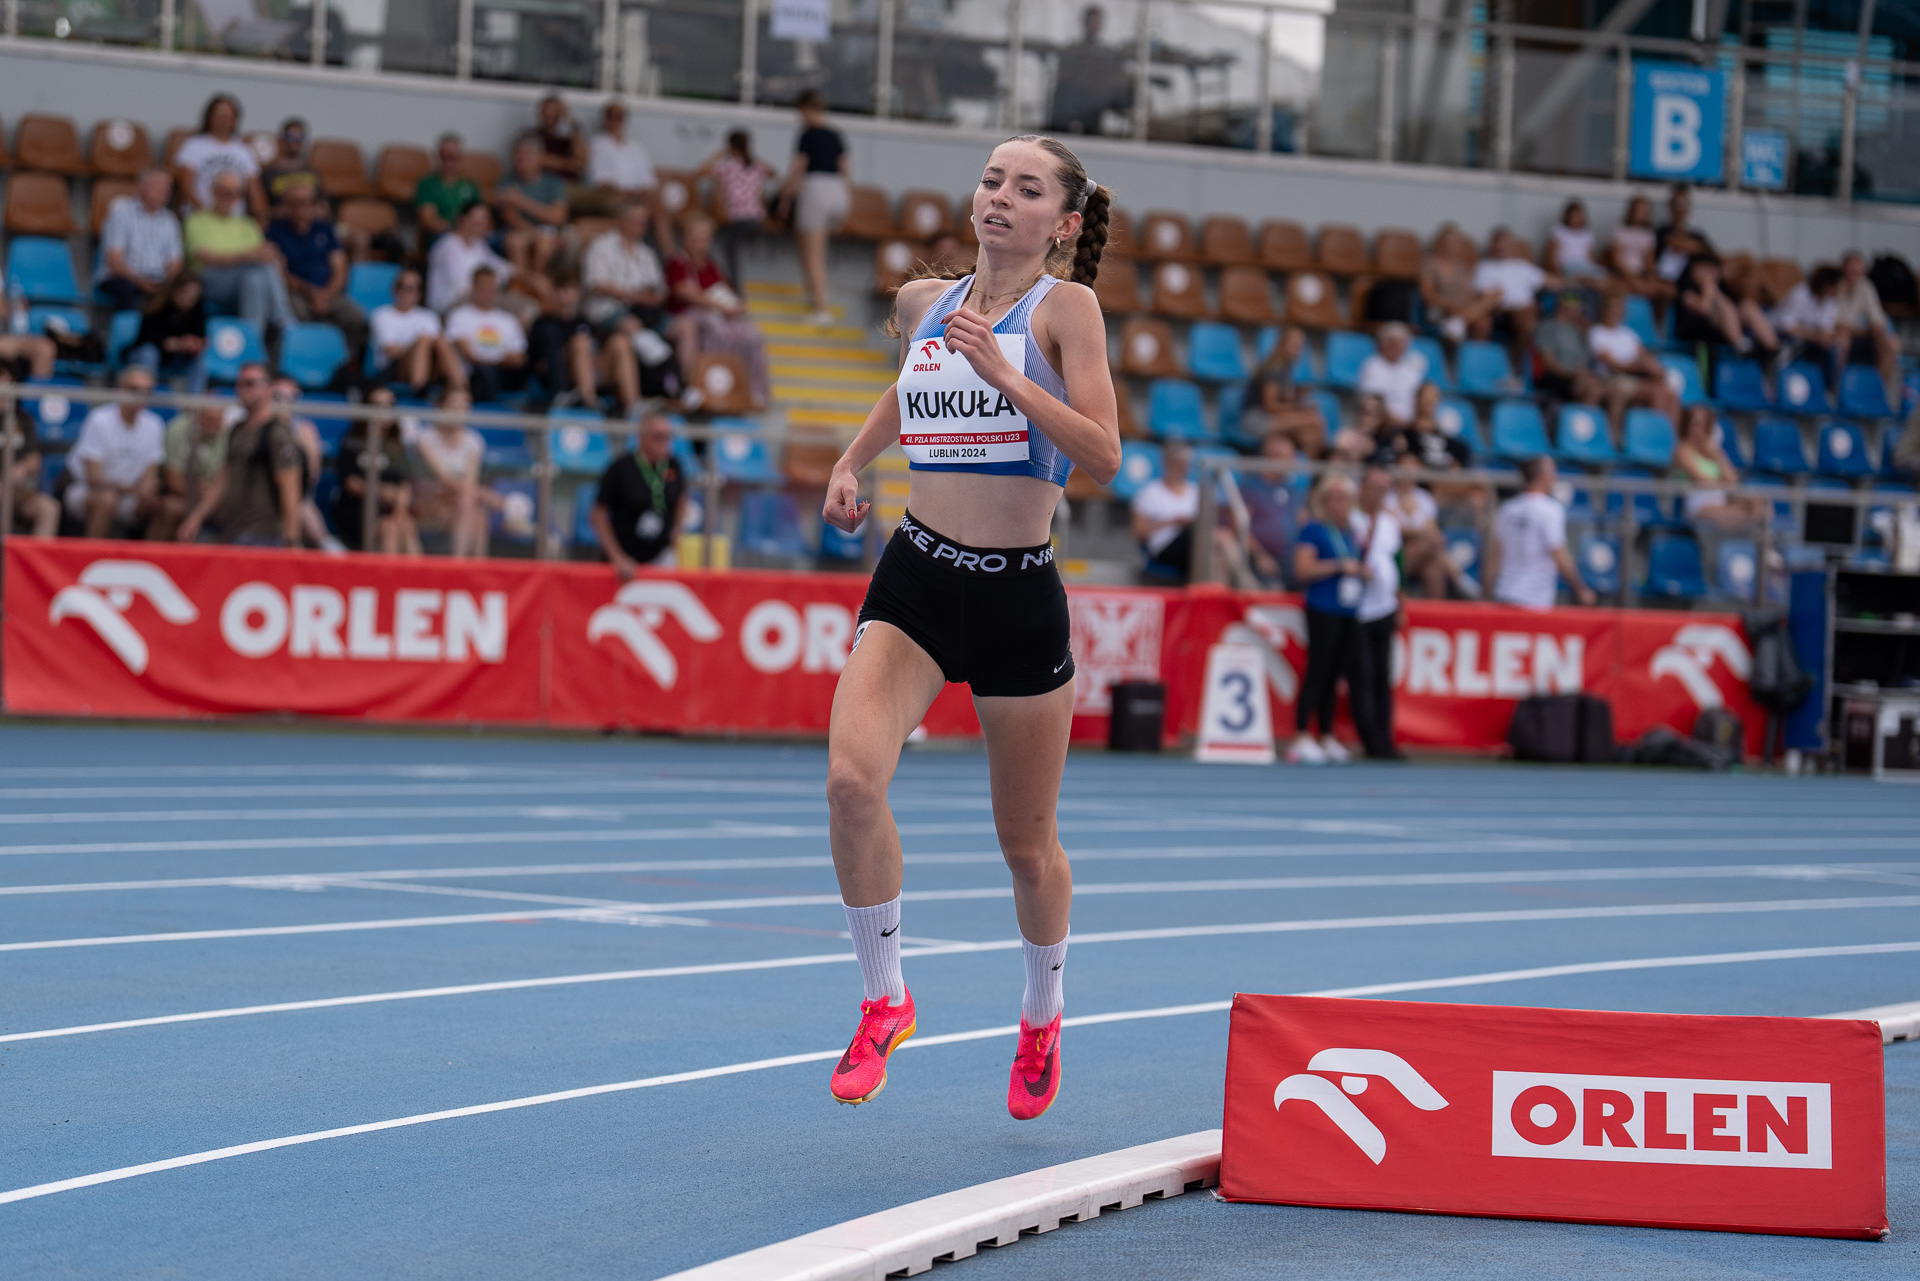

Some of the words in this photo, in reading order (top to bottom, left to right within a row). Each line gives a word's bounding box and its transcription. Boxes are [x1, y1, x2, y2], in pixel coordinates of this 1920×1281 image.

[1652, 97, 1702, 171] B
[913, 363, 941, 372] ORLEN
[906, 390, 1017, 419] KUKUŁA
[905, 436, 914, 444] 41.
[914, 436, 929, 444] PZLA
[929, 435, 975, 443] MISTRZOSTWA
[976, 434, 1003, 442] POLSKI
[1004, 433, 1020, 441] U23
[929, 448, 959, 458] LUBLIN
[961, 448, 986, 458] 2024
[932, 543, 1008, 573] PRO
[219, 581, 508, 664] ORLEN
[740, 599, 858, 674] OR
[1220, 671, 1254, 733] 3
[1510, 1085, 1809, 1155] ORLEN
